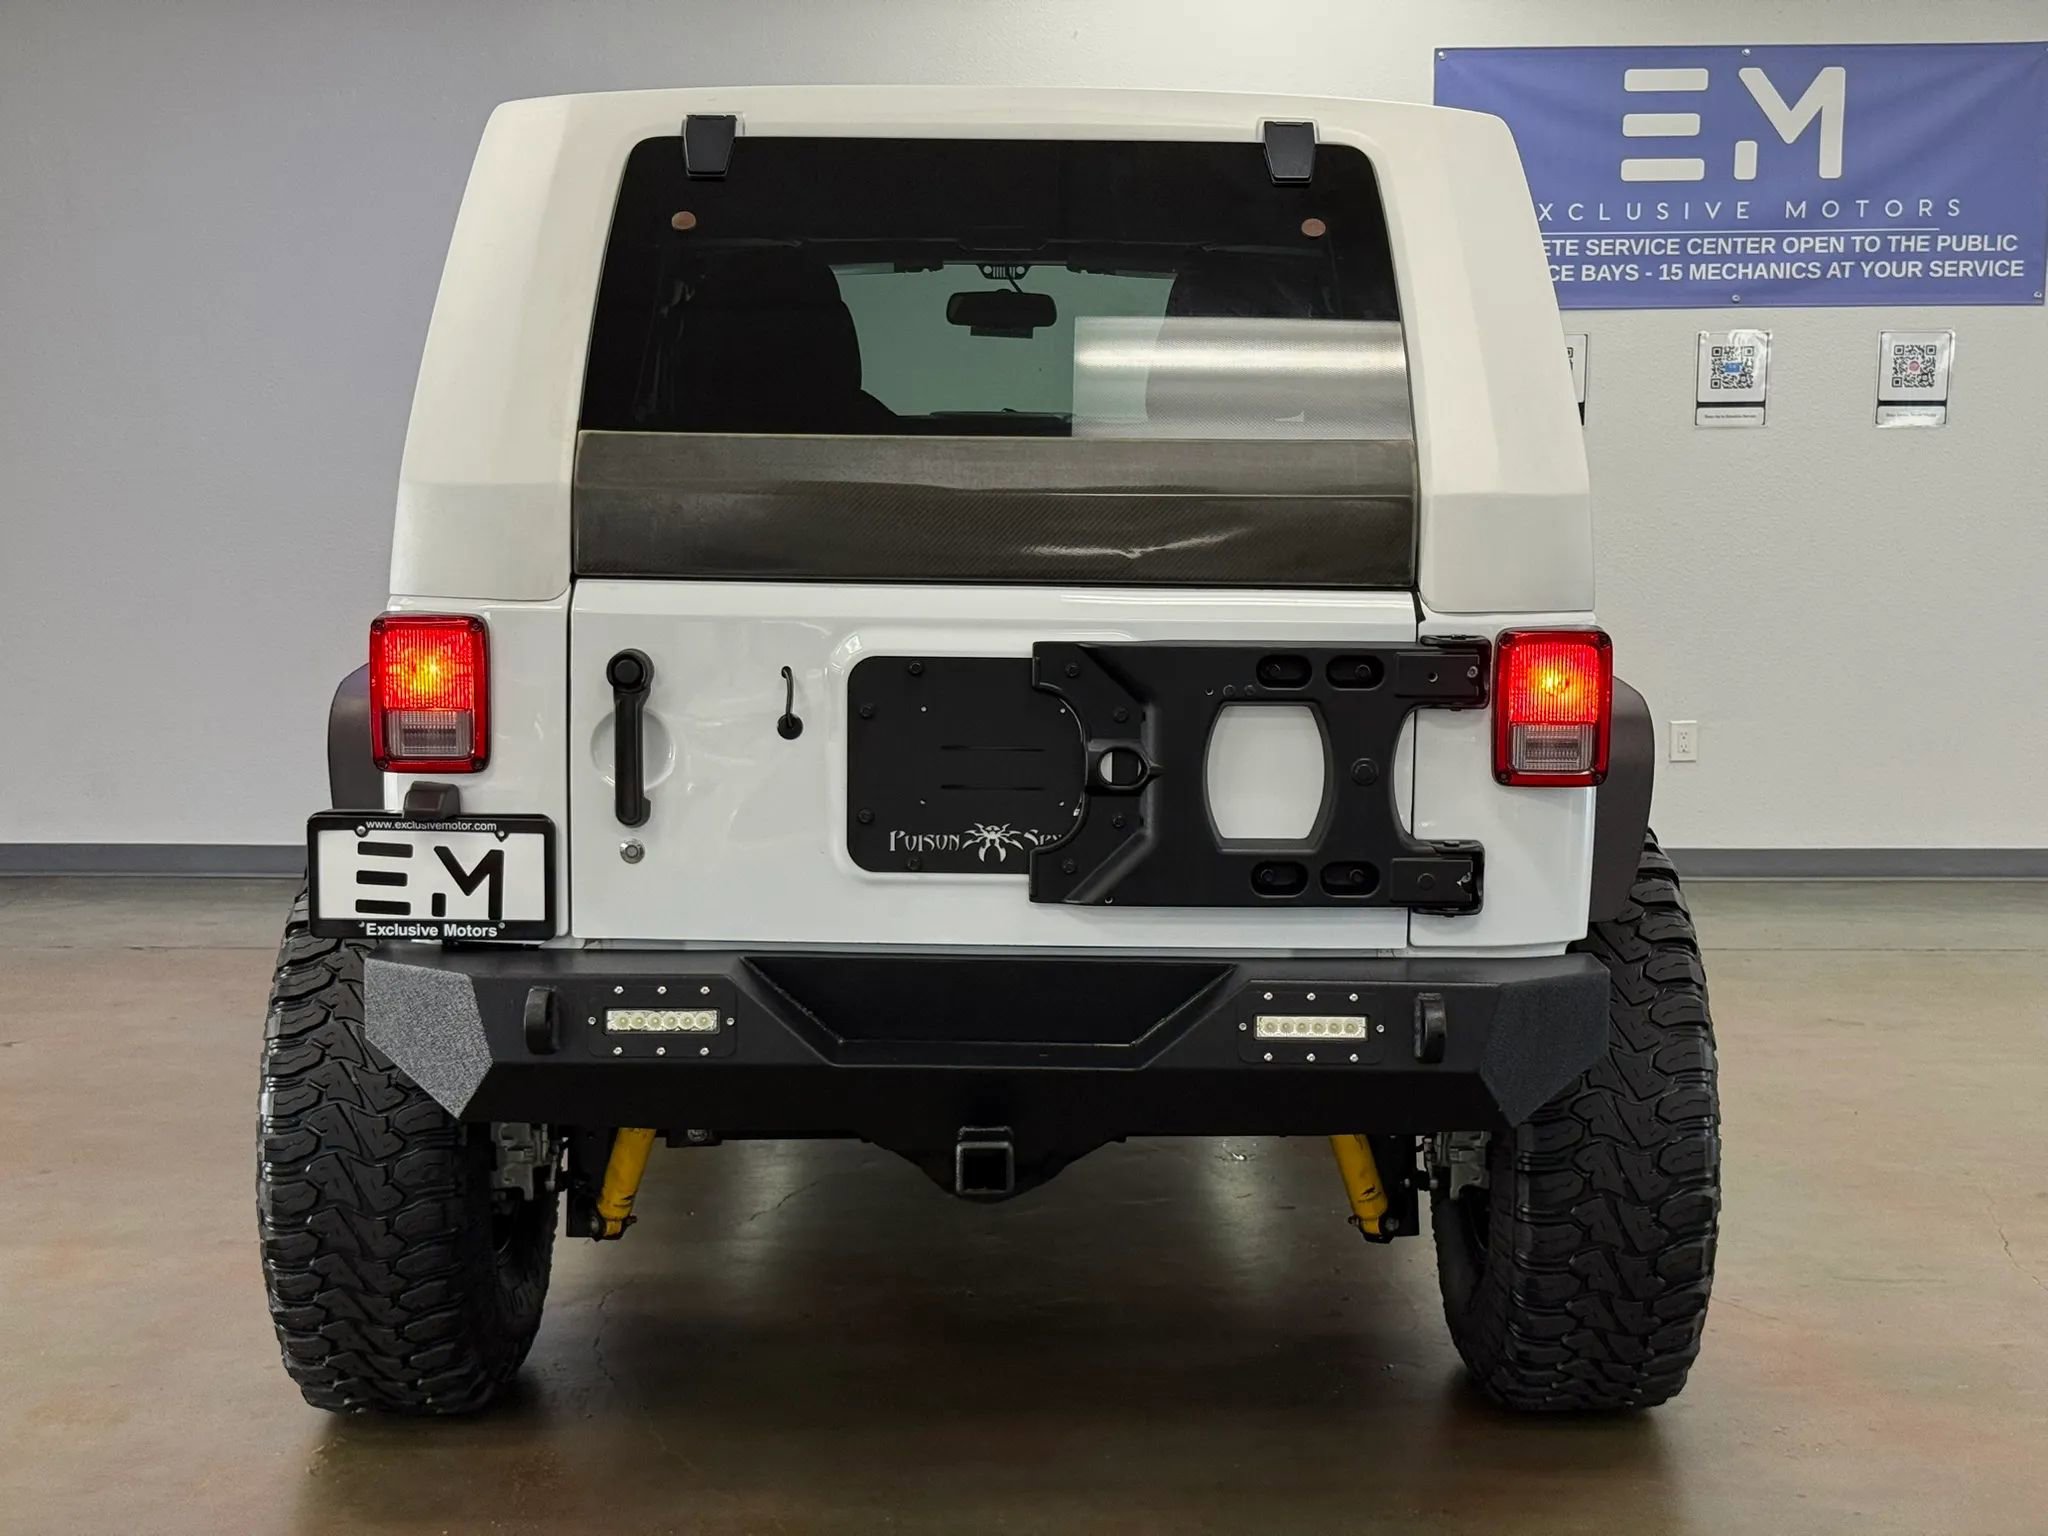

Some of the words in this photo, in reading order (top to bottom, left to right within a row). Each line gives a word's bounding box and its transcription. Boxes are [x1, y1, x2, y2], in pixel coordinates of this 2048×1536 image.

[1538, 201, 1750, 222] XCLUSIVE
[1785, 198, 1960, 220] MOTORS
[1542, 239, 1580, 257] ETE
[1585, 238, 1681, 256] SERVICE
[1686, 237, 1776, 255] CENTER
[1782, 236, 1845, 254] OPEN
[1850, 235, 1881, 253] TO
[1886, 235, 1931, 253] THE
[1936, 234, 2018, 252] PUBLIC
[1551, 264, 1575, 282] CE
[1581, 263, 1639, 282] BAYS
[1658, 263, 1683, 281] 15
[1689, 261, 1822, 281] MECHANICS
[1826, 261, 1855, 279] AT
[1860, 260, 1923, 278] YOUR
[1928, 259, 2025, 278] SERVICE
[365, 819, 498, 832] www.exclusivemotor.com
[365, 922, 439, 937] Exclusive
[443, 923, 498, 938] Motors
